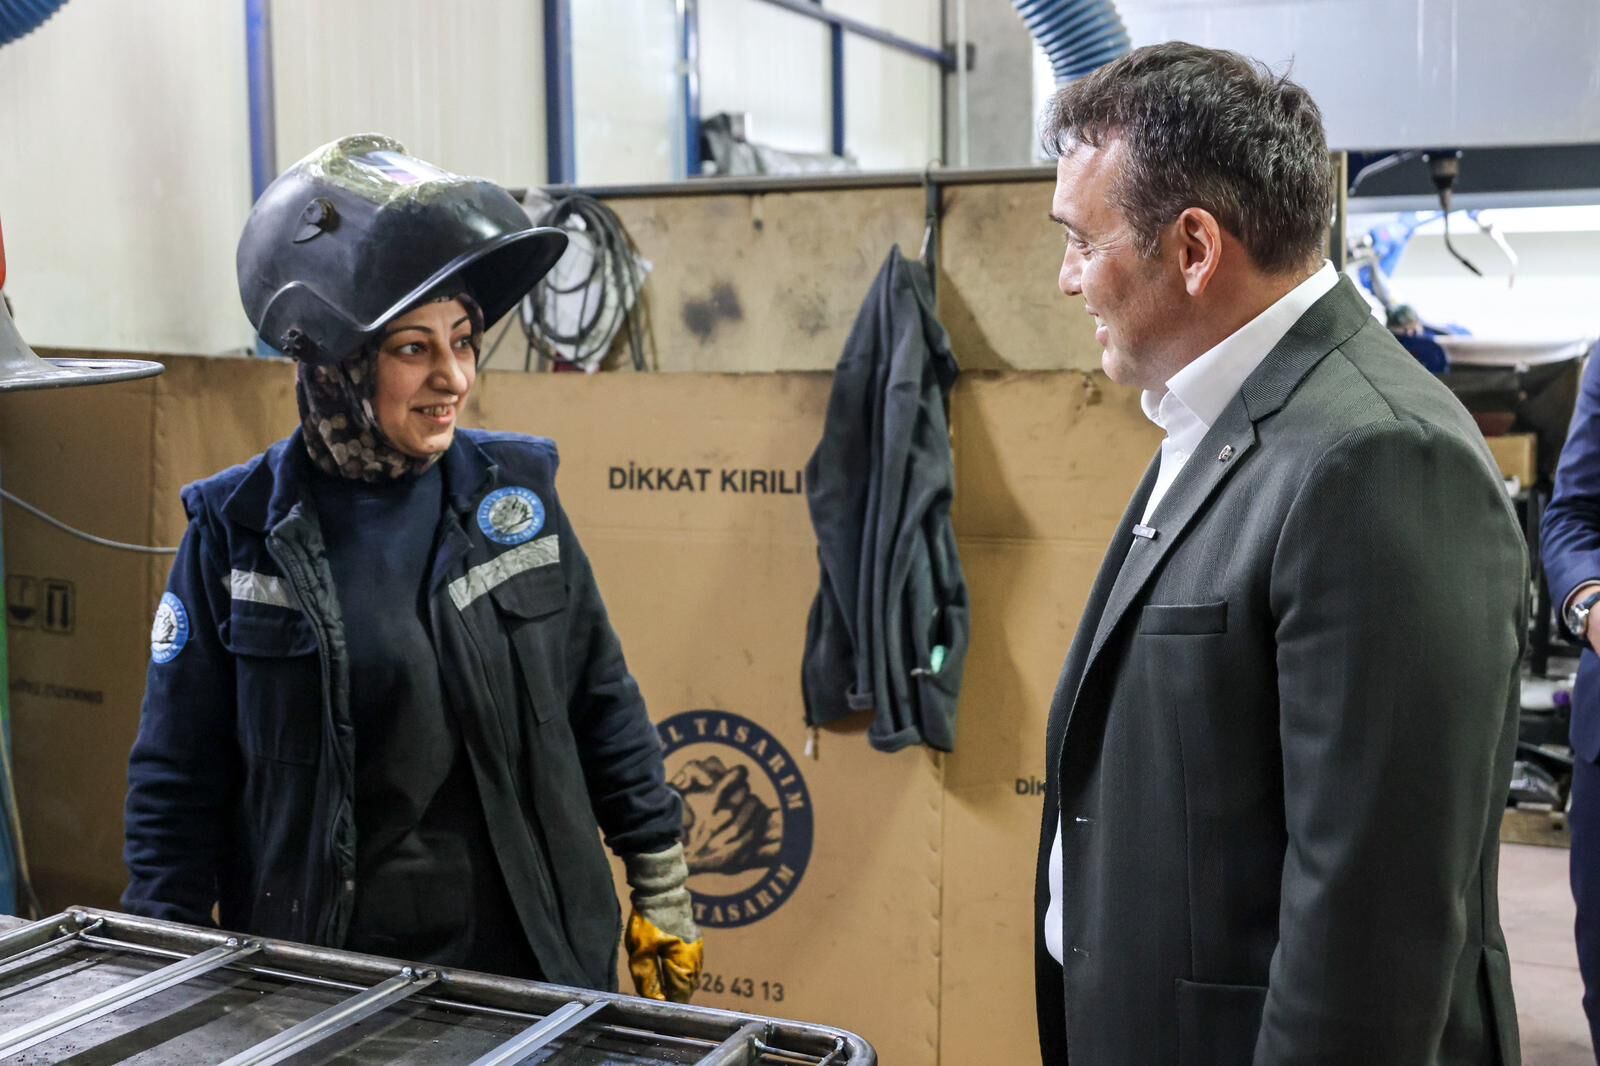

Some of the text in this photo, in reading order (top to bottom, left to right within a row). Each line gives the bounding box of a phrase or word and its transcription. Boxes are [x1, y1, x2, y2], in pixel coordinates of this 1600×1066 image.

[608, 460, 712, 493] DİKKAT
[693, 717, 805, 809] TASARIM
[692, 863, 796, 924] TASARIM
[695, 972, 785, 1003] 26 43 13
